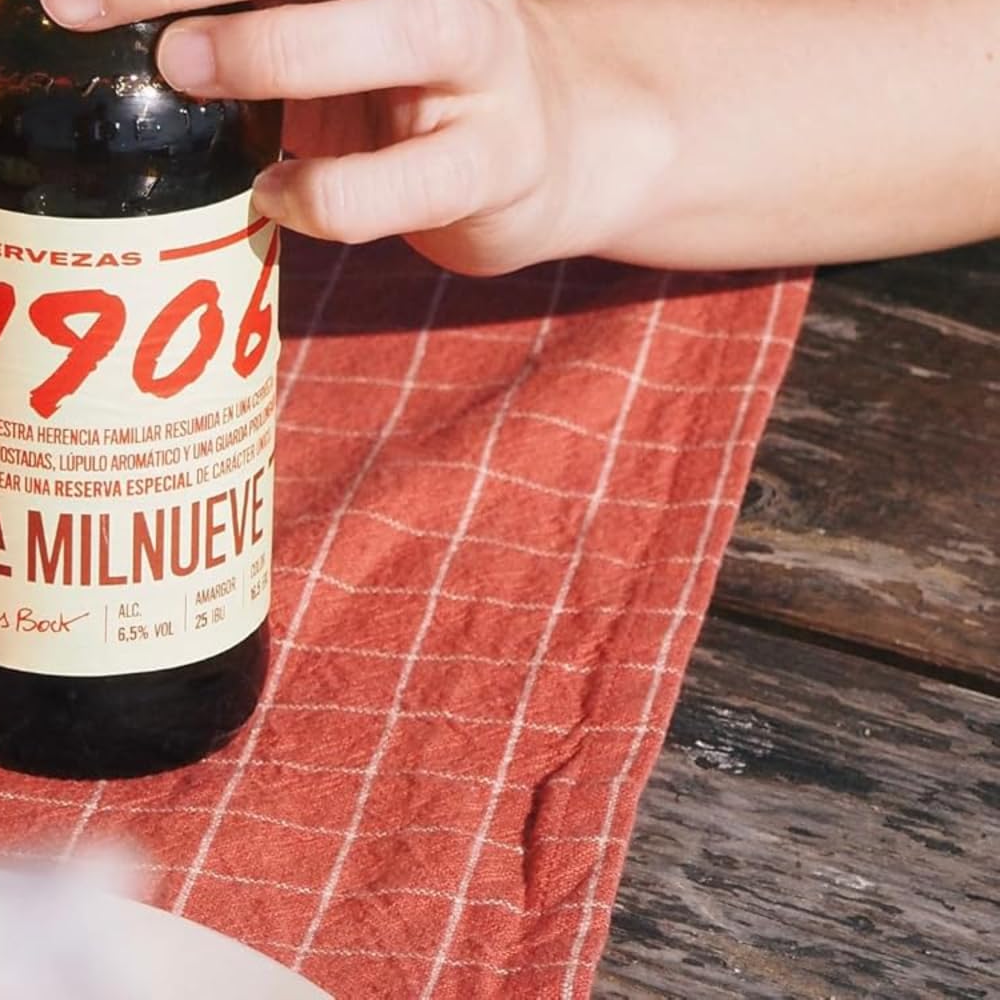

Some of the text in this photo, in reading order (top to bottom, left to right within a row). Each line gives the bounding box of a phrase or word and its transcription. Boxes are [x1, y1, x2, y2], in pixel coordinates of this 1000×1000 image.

[37, 426, 100, 445] HERENCIA
[104, 425, 161, 446] FAMILIAR
[165, 411, 220, 440] RESUMIDA
[223, 405, 234, 425] EN
[235, 396, 251, 417] UNA
[59, 452, 107, 472] LÚPULO
[111, 447, 180, 471] AROMÁTICO
[184, 445, 192, 461] Y
[193, 438, 213, 460] UNA
[215, 424, 248, 453] GUARDA
[24, 476, 50, 495] UNA
[54, 479, 121, 497] RESERVA
[126, 472, 193, 496] ESPECIAL
[196, 467, 210, 485] DE
[27, 467, 264, 586] MILNUEVE
[195, 576, 237, 606] AMARGOR
[16, 607, 90, 632] Bock
[118, 602, 142, 618] ALC.
[195, 605, 226, 629] 25 IBU
[154, 621, 175, 638] VOL
